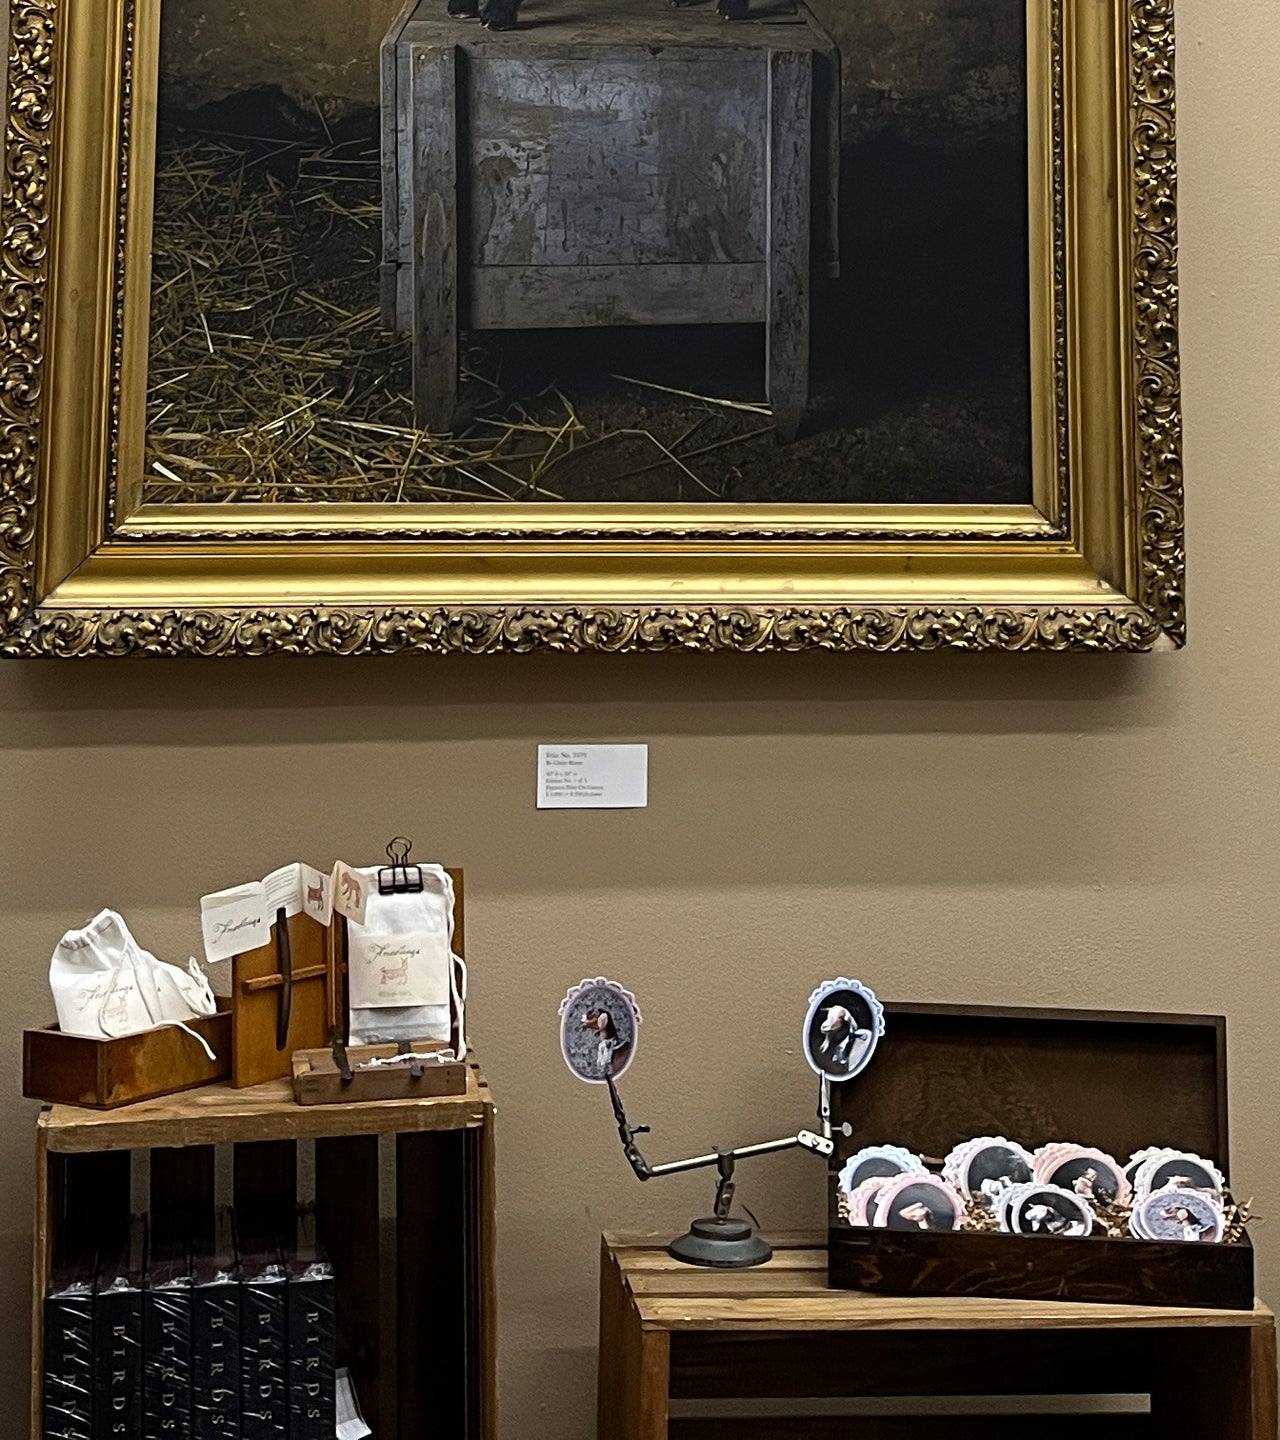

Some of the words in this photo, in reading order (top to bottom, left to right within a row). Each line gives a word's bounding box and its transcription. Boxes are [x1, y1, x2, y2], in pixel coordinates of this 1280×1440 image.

[112, 1324, 126, 1433] BIRDS
[161, 1321, 175, 1429] BIRDS
[210, 1316, 224, 1425] BIRDS
[258, 1312, 273, 1420] BIRDS
[306, 1311, 320, 1419] BIRDS
